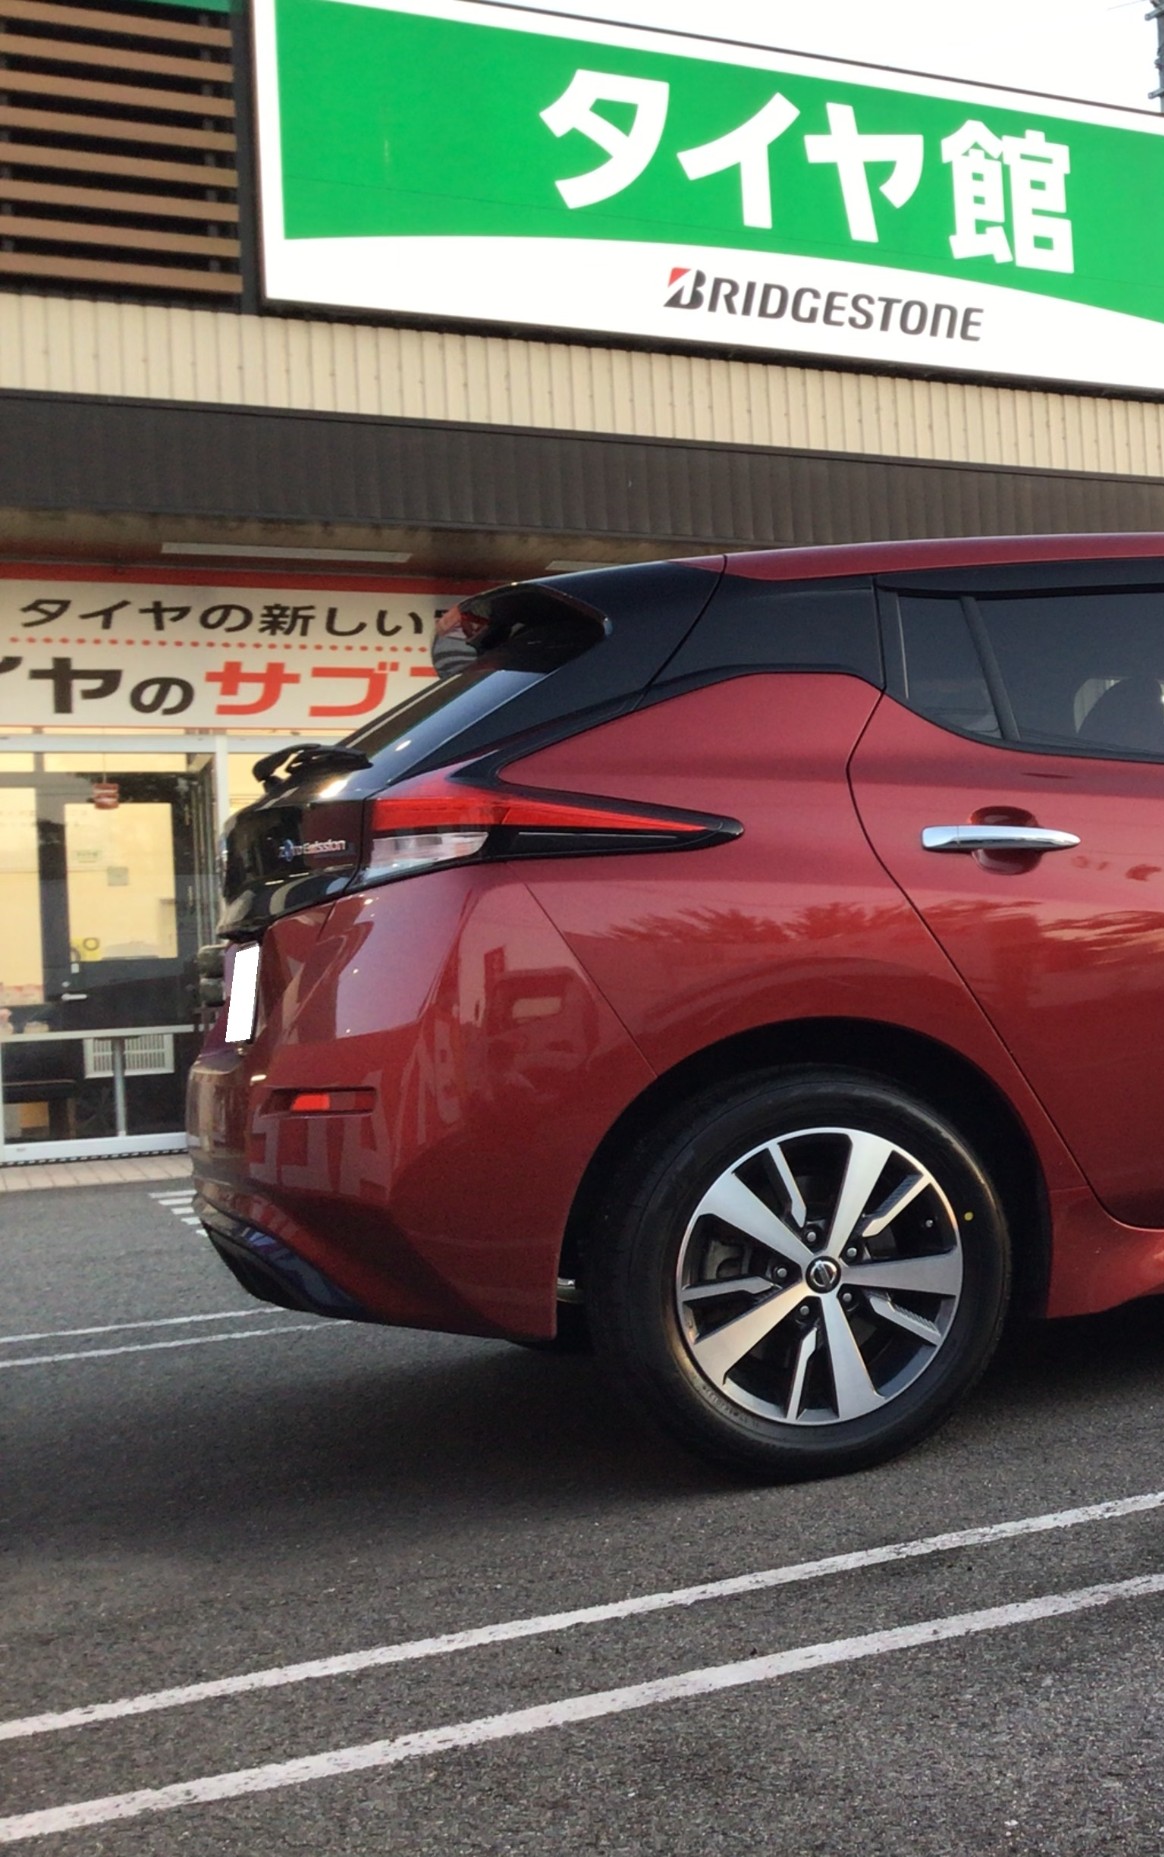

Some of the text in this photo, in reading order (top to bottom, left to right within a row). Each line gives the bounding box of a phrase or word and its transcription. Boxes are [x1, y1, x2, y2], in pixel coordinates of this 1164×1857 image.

[539, 68, 1075, 274] タイヤ館
[663, 266, 985, 342] BRIDGESTONE
[20, 598, 448, 638] タイヤの新しい
